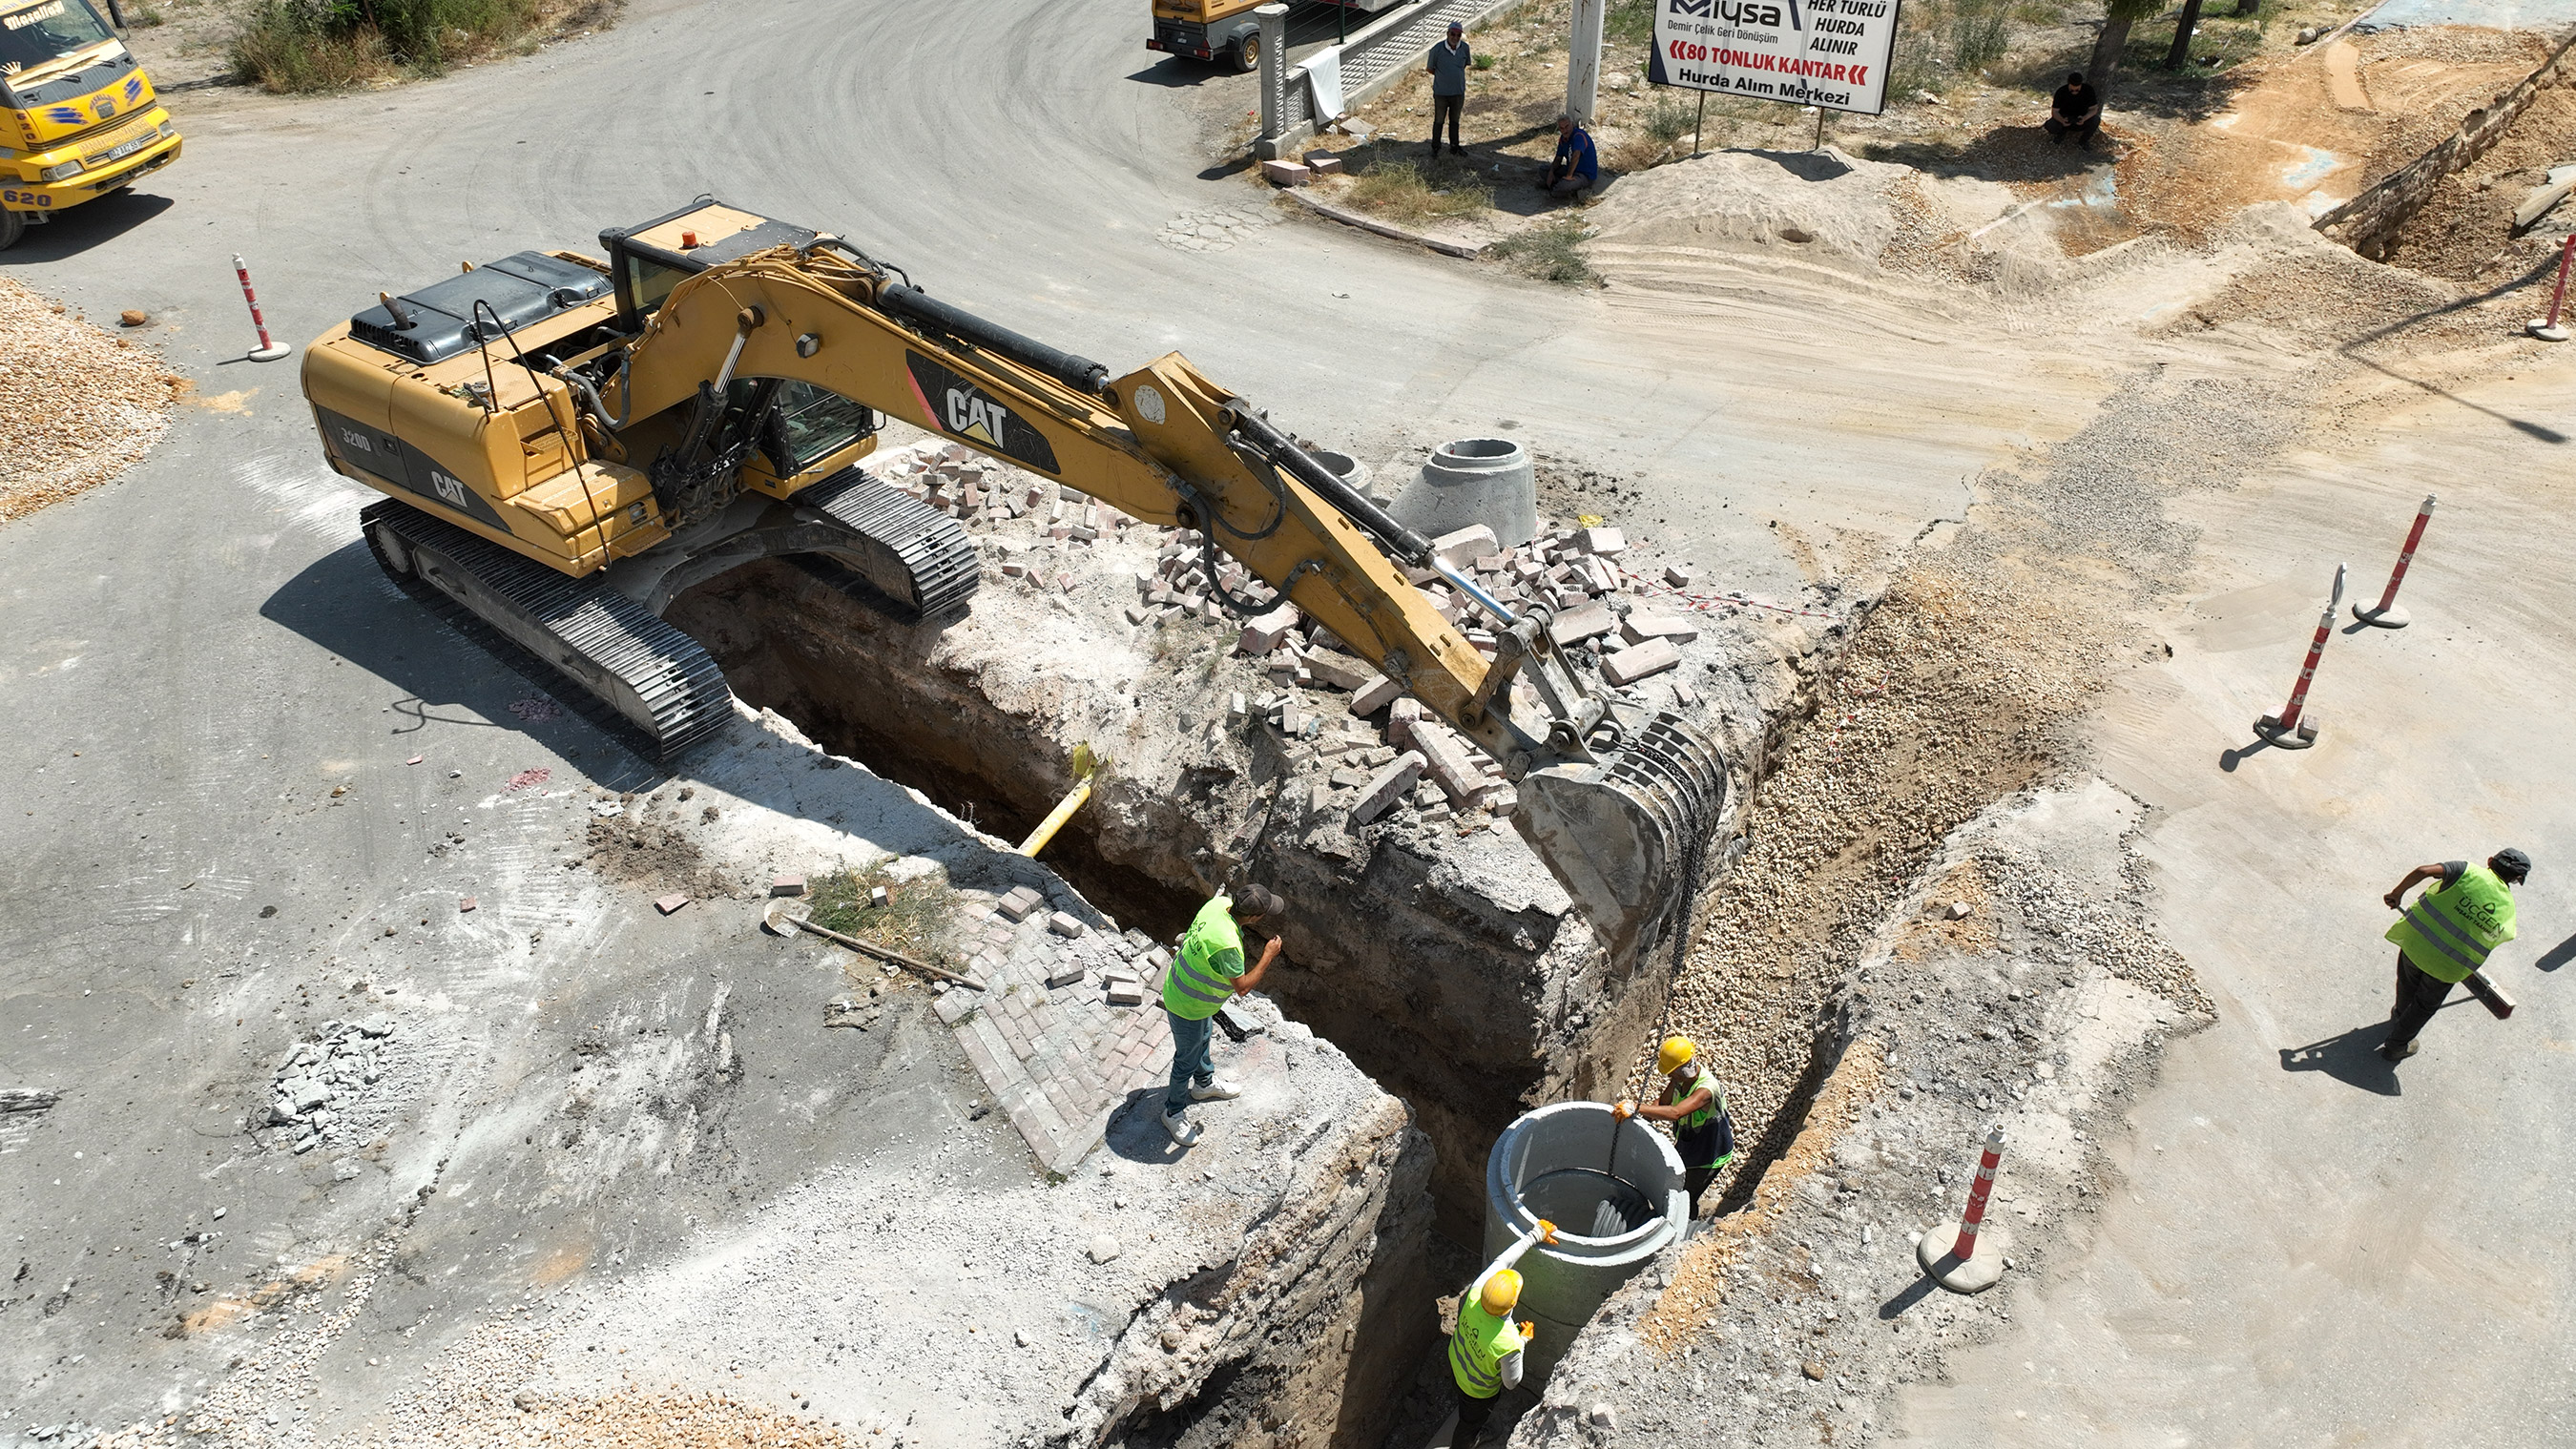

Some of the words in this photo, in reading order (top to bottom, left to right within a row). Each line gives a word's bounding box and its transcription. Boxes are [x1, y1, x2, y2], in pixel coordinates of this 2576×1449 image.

[1807, 0, 1837, 12] HER
[1668, 20, 1693, 32] Demir
[1694, 23, 1715, 36] Çelik
[1717, 27, 1735, 38] Geri
[1737, 30, 1778, 44] Dönüşüm
[1815, 17, 1865, 36] HURDA
[1809, 37, 1859, 55] ALINIR
[1687, 44, 1708, 62] 80
[1712, 47, 1776, 72] TONLUK
[1778, 56, 1847, 81] KANTAR
[1679, 68, 1730, 88] Hurda
[1735, 76, 1774, 94] Alım
[1779, 83, 1851, 105] Merkezi
[4, 190, 52, 207] 620
[946, 387, 1007, 449] CAT
[341, 427, 372, 453] 320D
[431, 470, 468, 508] CAT
